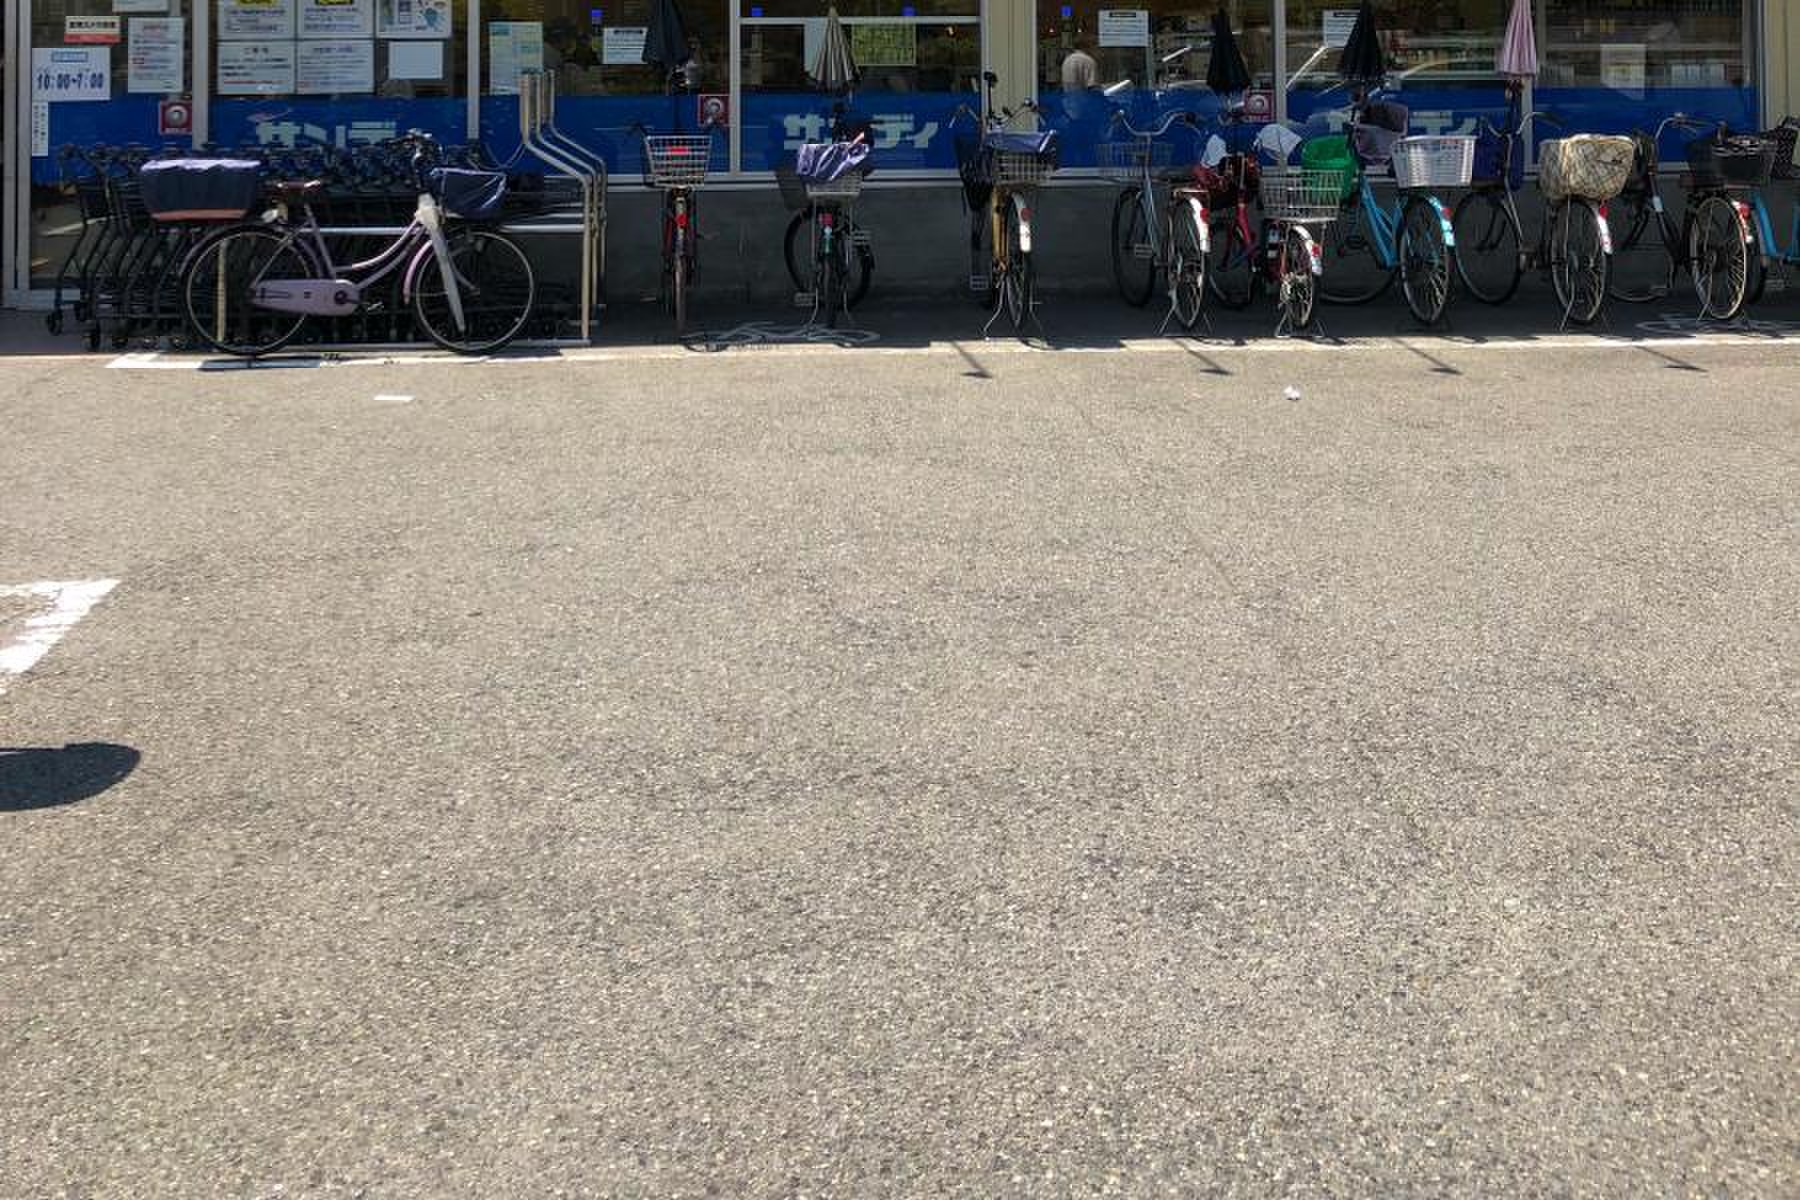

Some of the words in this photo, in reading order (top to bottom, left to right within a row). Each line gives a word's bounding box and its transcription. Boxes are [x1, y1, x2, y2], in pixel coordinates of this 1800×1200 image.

[256, 121, 397, 150] サンデ
[784, 114, 938, 150] サディ
